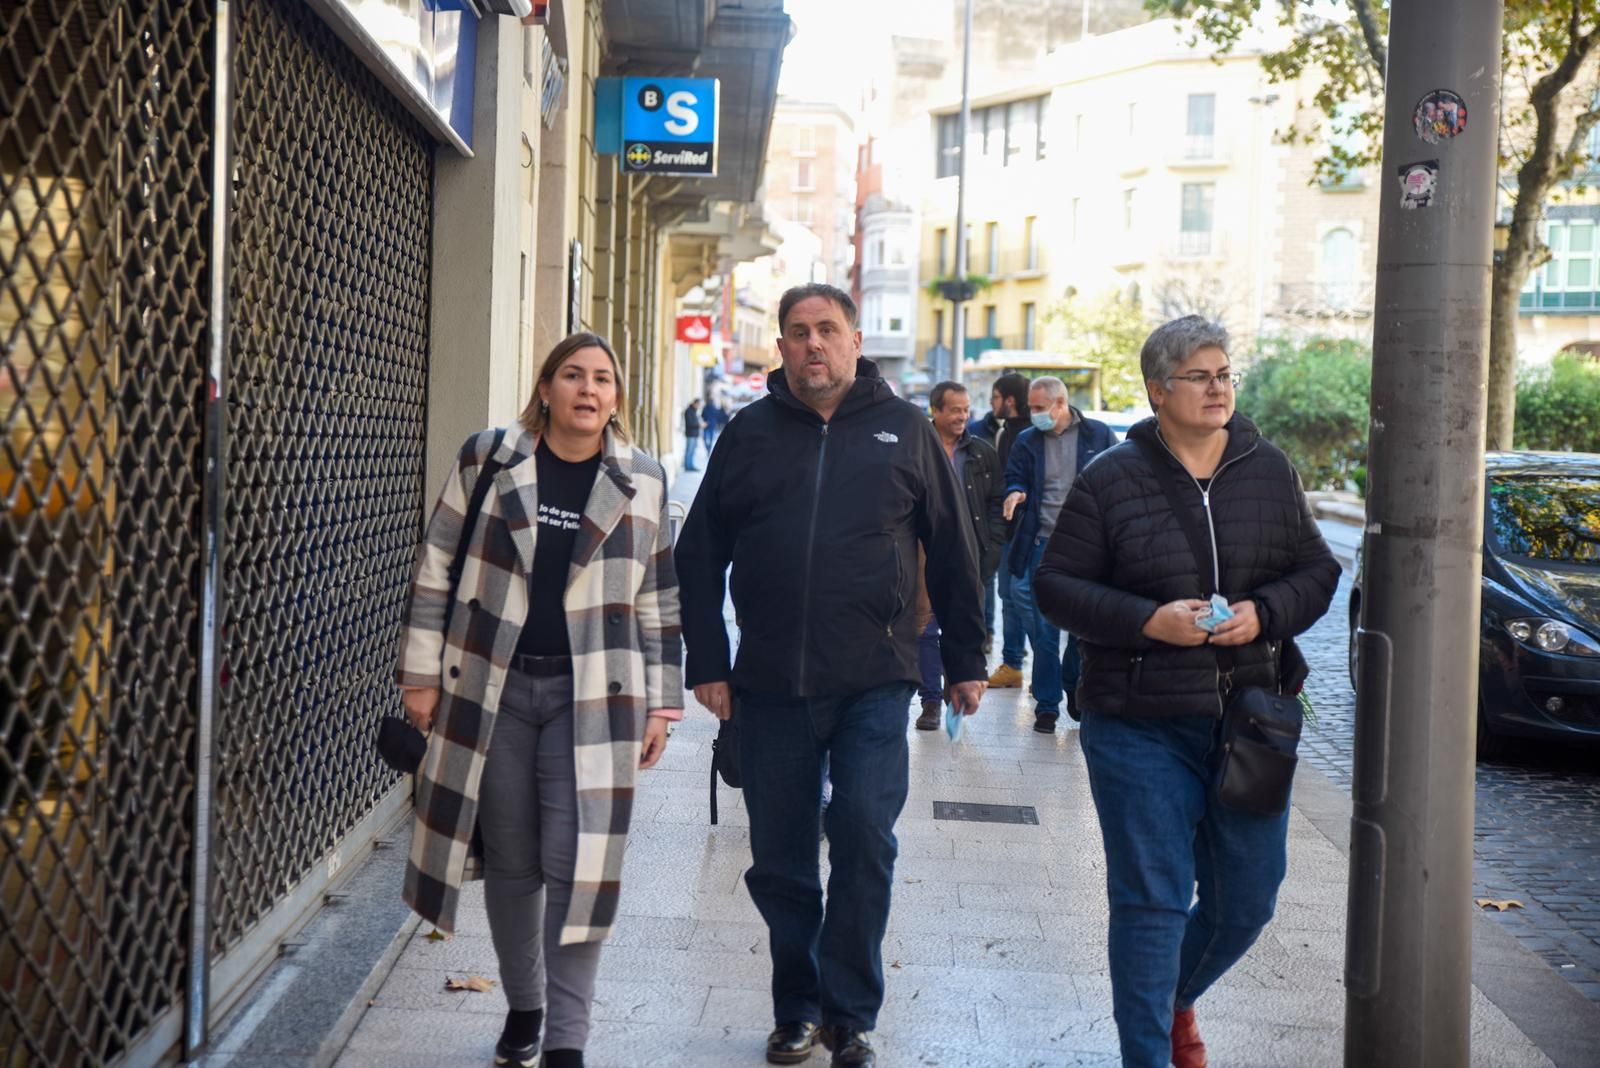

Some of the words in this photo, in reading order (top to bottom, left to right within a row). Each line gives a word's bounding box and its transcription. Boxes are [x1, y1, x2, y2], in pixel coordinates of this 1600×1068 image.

[644, 90, 658, 107] B
[663, 90, 699, 136] S
[653, 150, 708, 165] ServiRed
[539, 504, 548, 513] Jo
[549, 506, 560, 516] de
[560, 510, 580, 520] gran
[537, 515, 548, 523] ull
[549, 518, 562, 527] ser
